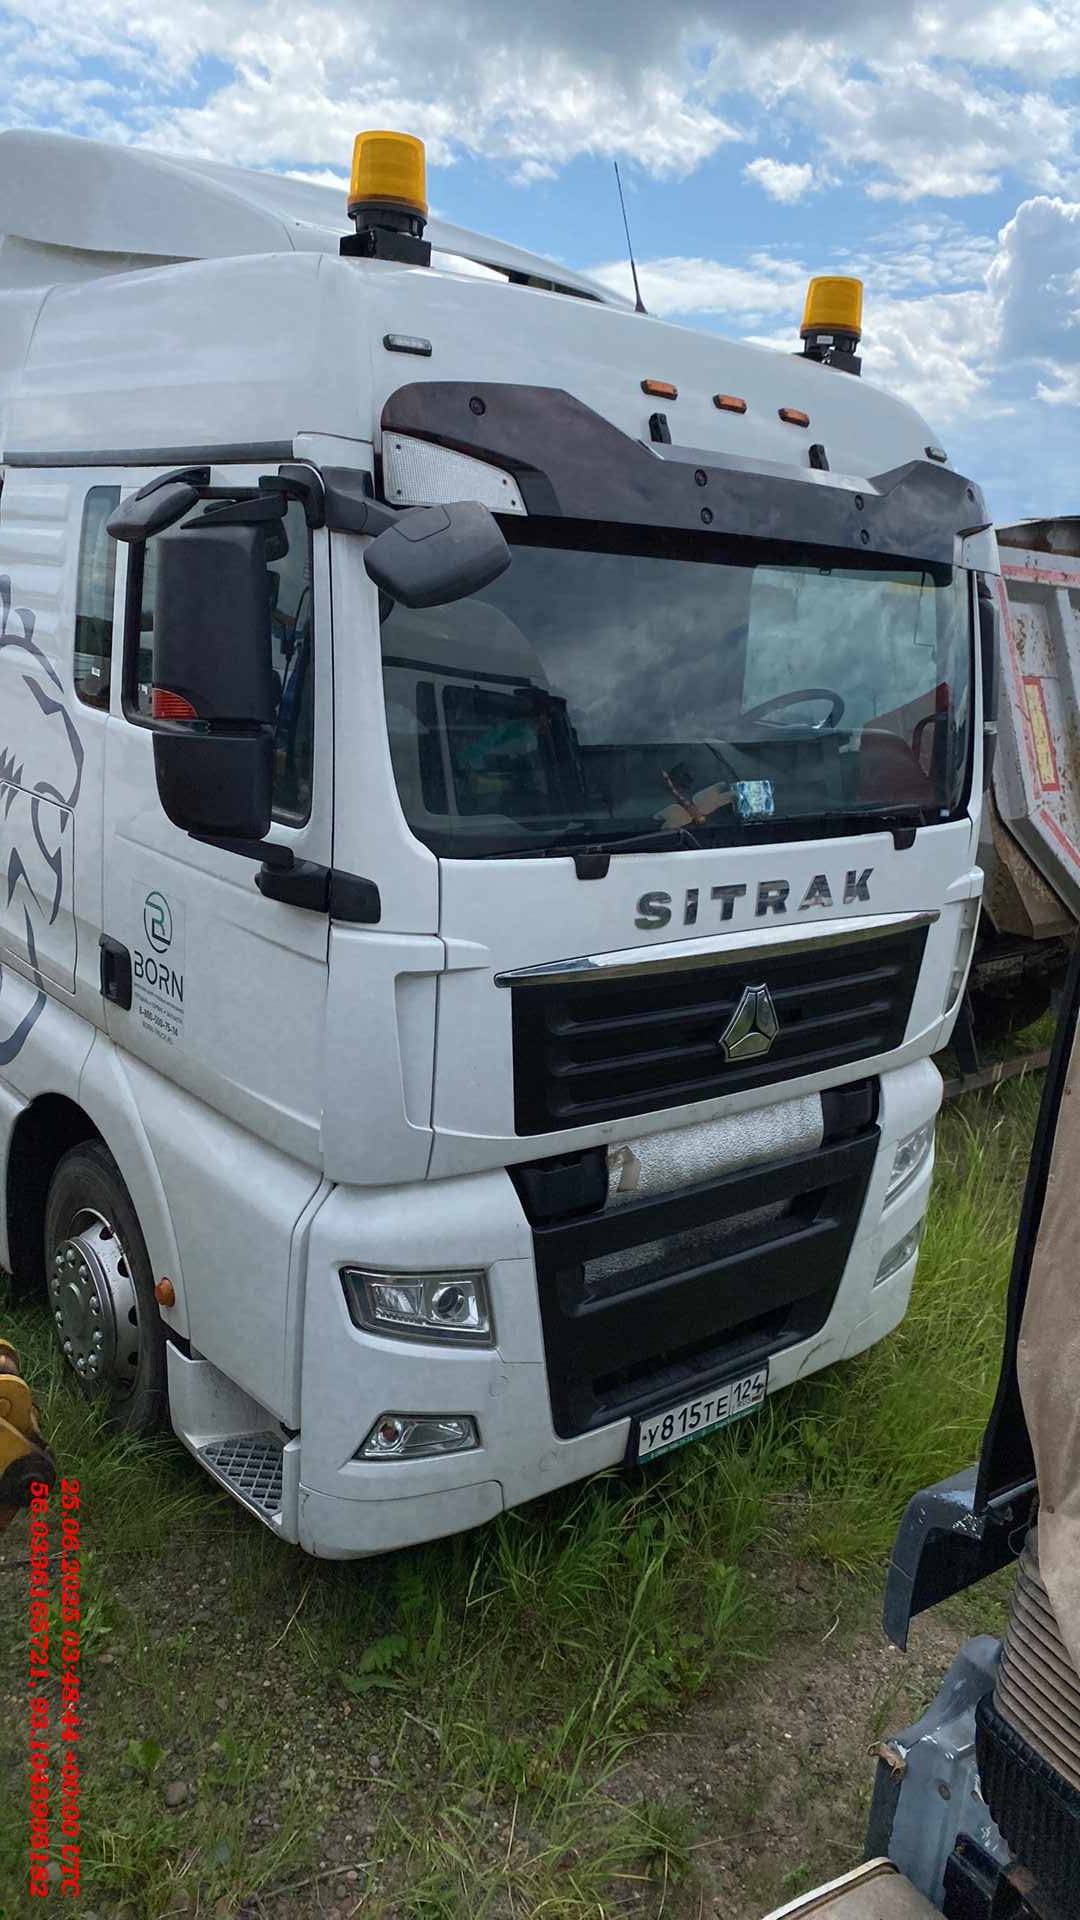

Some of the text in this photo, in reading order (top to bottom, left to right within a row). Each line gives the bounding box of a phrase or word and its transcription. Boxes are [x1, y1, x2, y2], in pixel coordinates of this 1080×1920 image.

[634, 867, 874, 930] SITRAK
[134, 950, 184, 1003] BORN
[733, 1375, 764, 1401] 124
